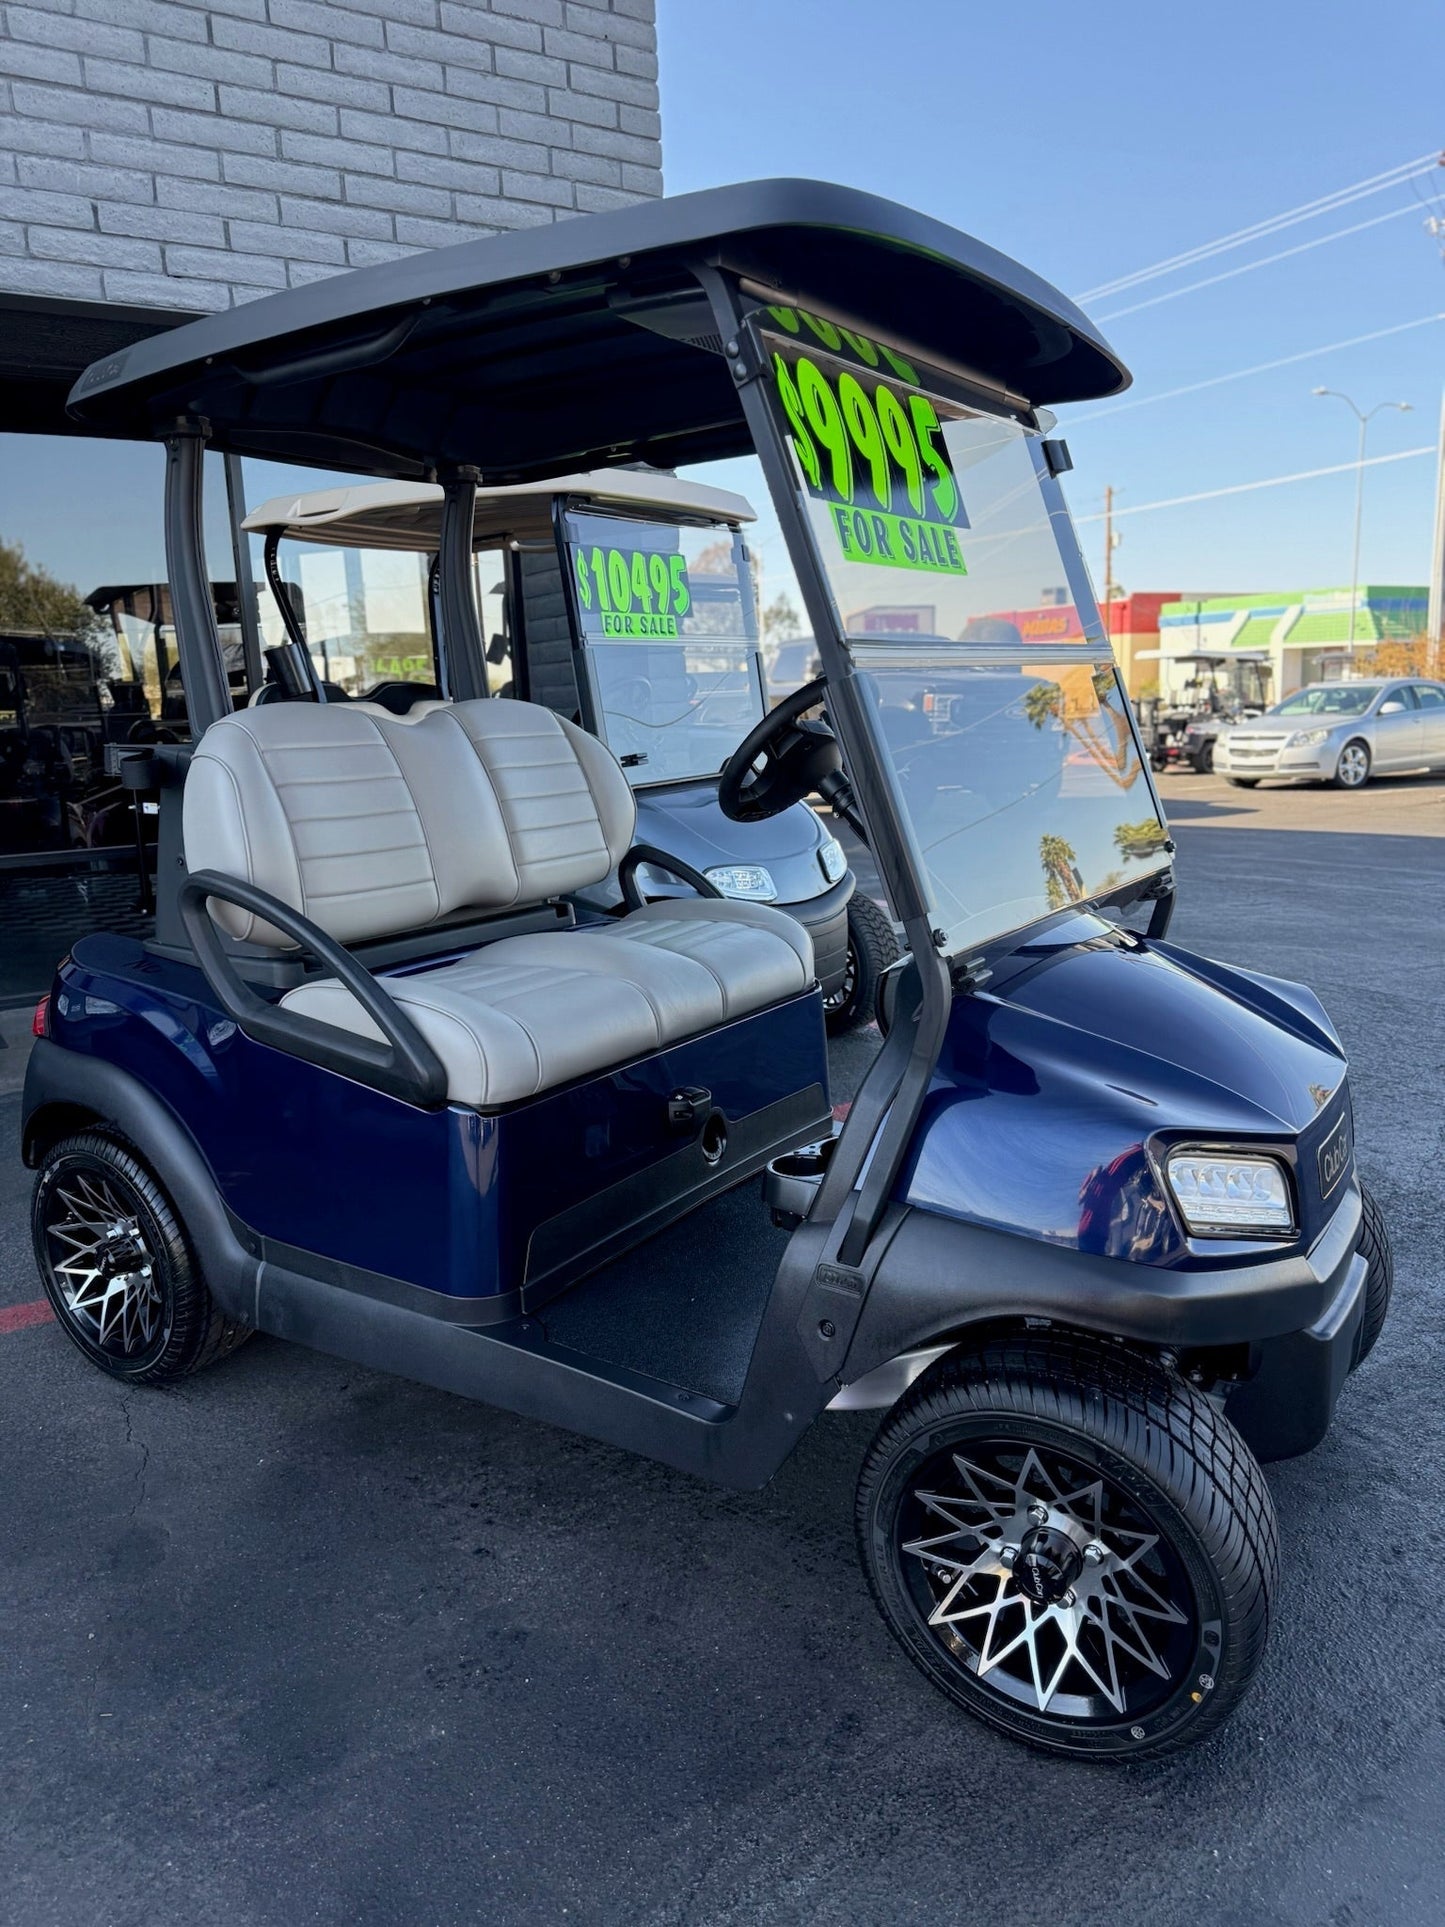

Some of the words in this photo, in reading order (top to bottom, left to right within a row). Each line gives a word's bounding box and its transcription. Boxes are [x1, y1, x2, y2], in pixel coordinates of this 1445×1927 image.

[774, 352, 958, 522] $9995
[834, 508, 894, 560] FOR
[900, 520, 961, 569] SALE
[576, 547, 690, 616] $10495
[604, 614, 634, 635] FOR
[640, 616, 676, 637] SALE
